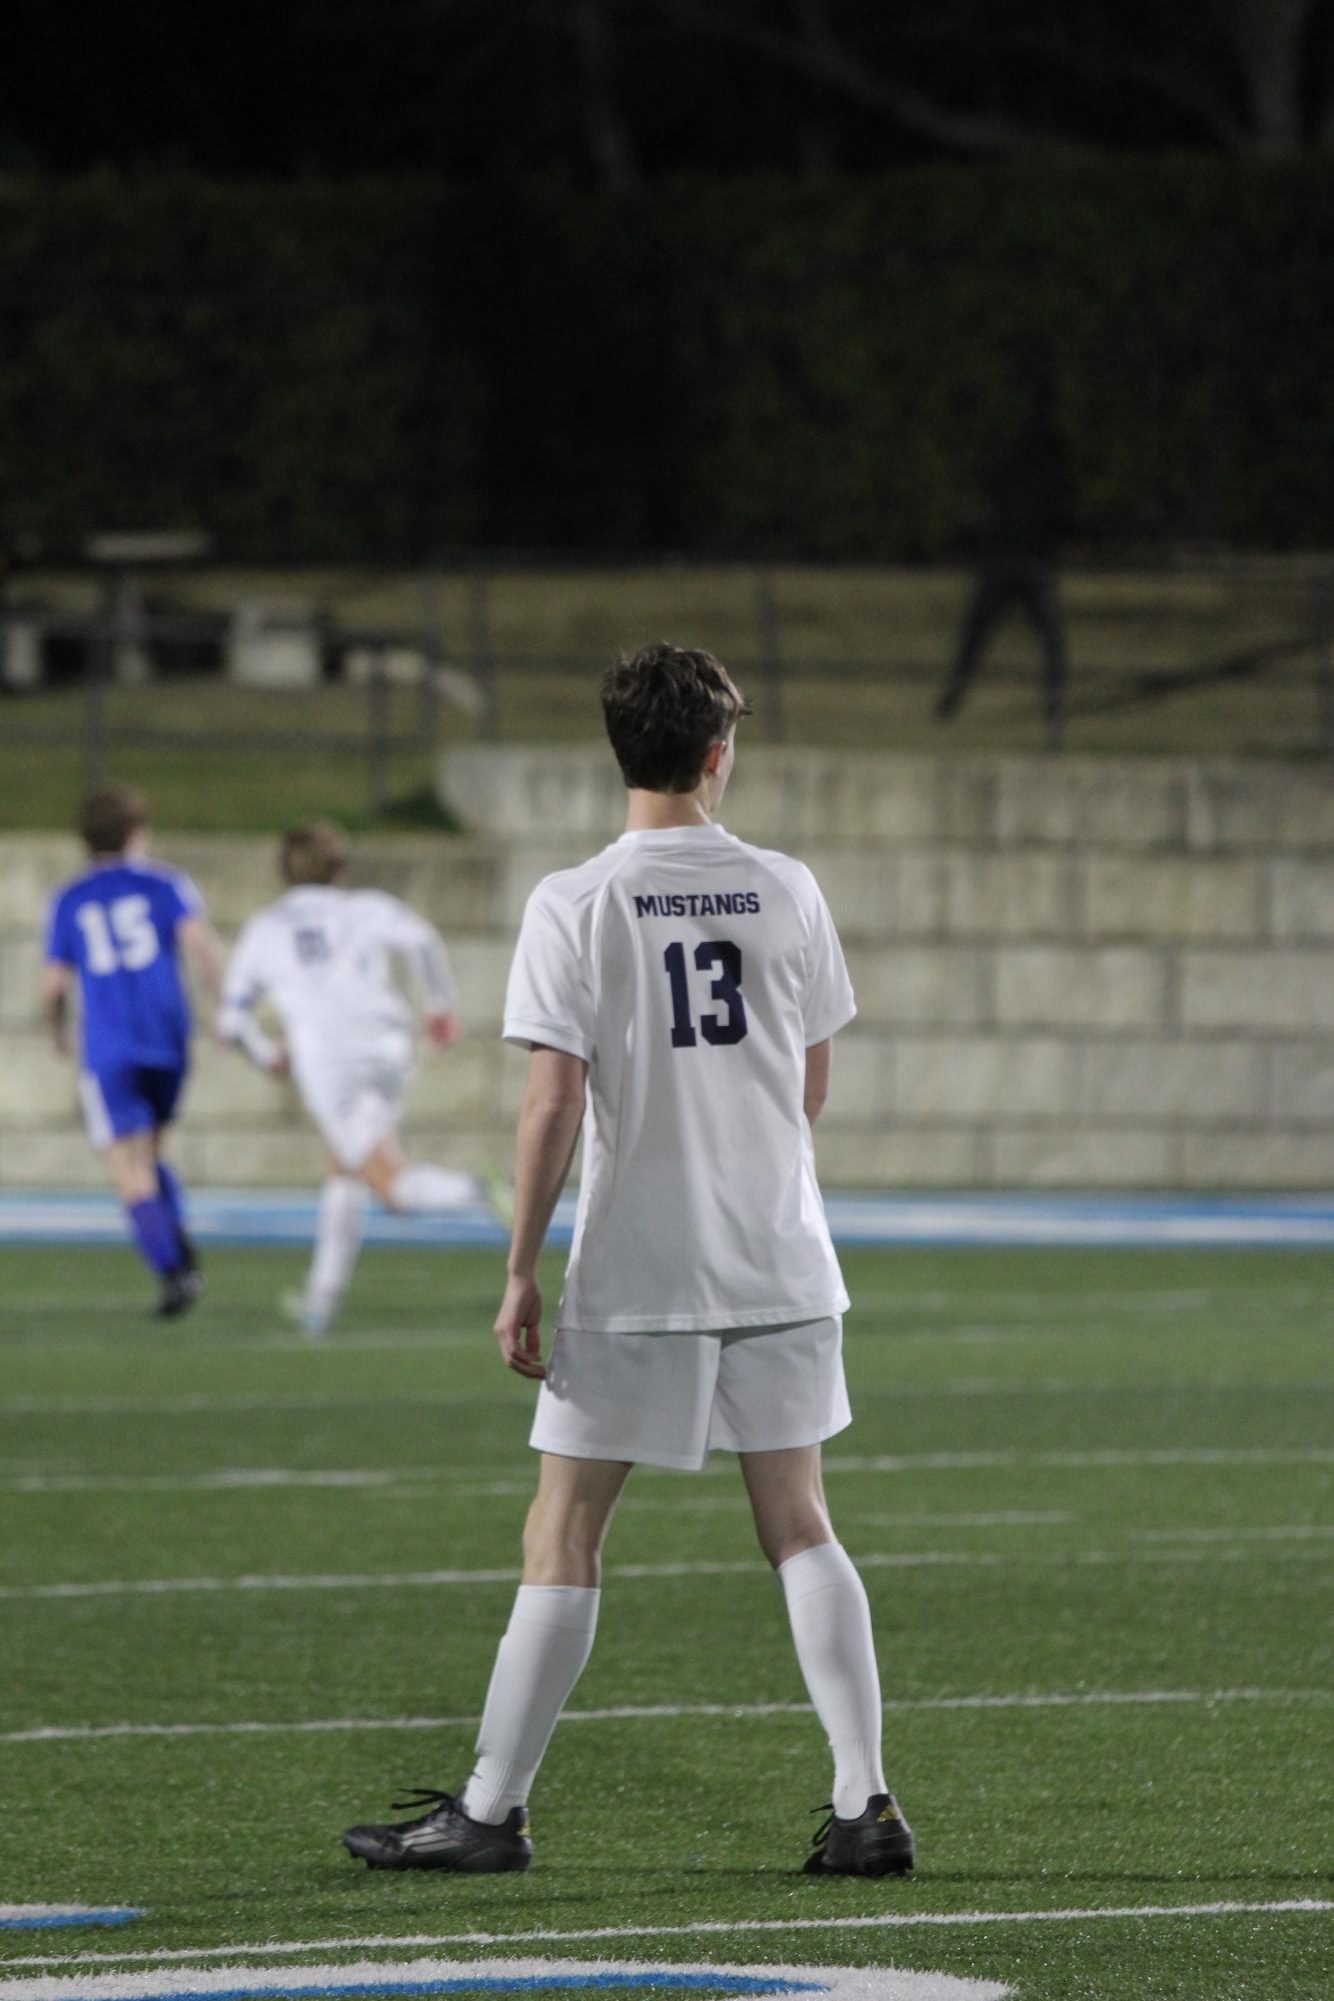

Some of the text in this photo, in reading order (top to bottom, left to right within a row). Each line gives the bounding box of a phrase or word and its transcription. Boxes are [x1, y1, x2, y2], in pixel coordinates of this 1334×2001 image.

[76, 894, 159, 976] 15
[633, 892, 760, 918] MUSTANGS
[664, 941, 748, 1047] 13
